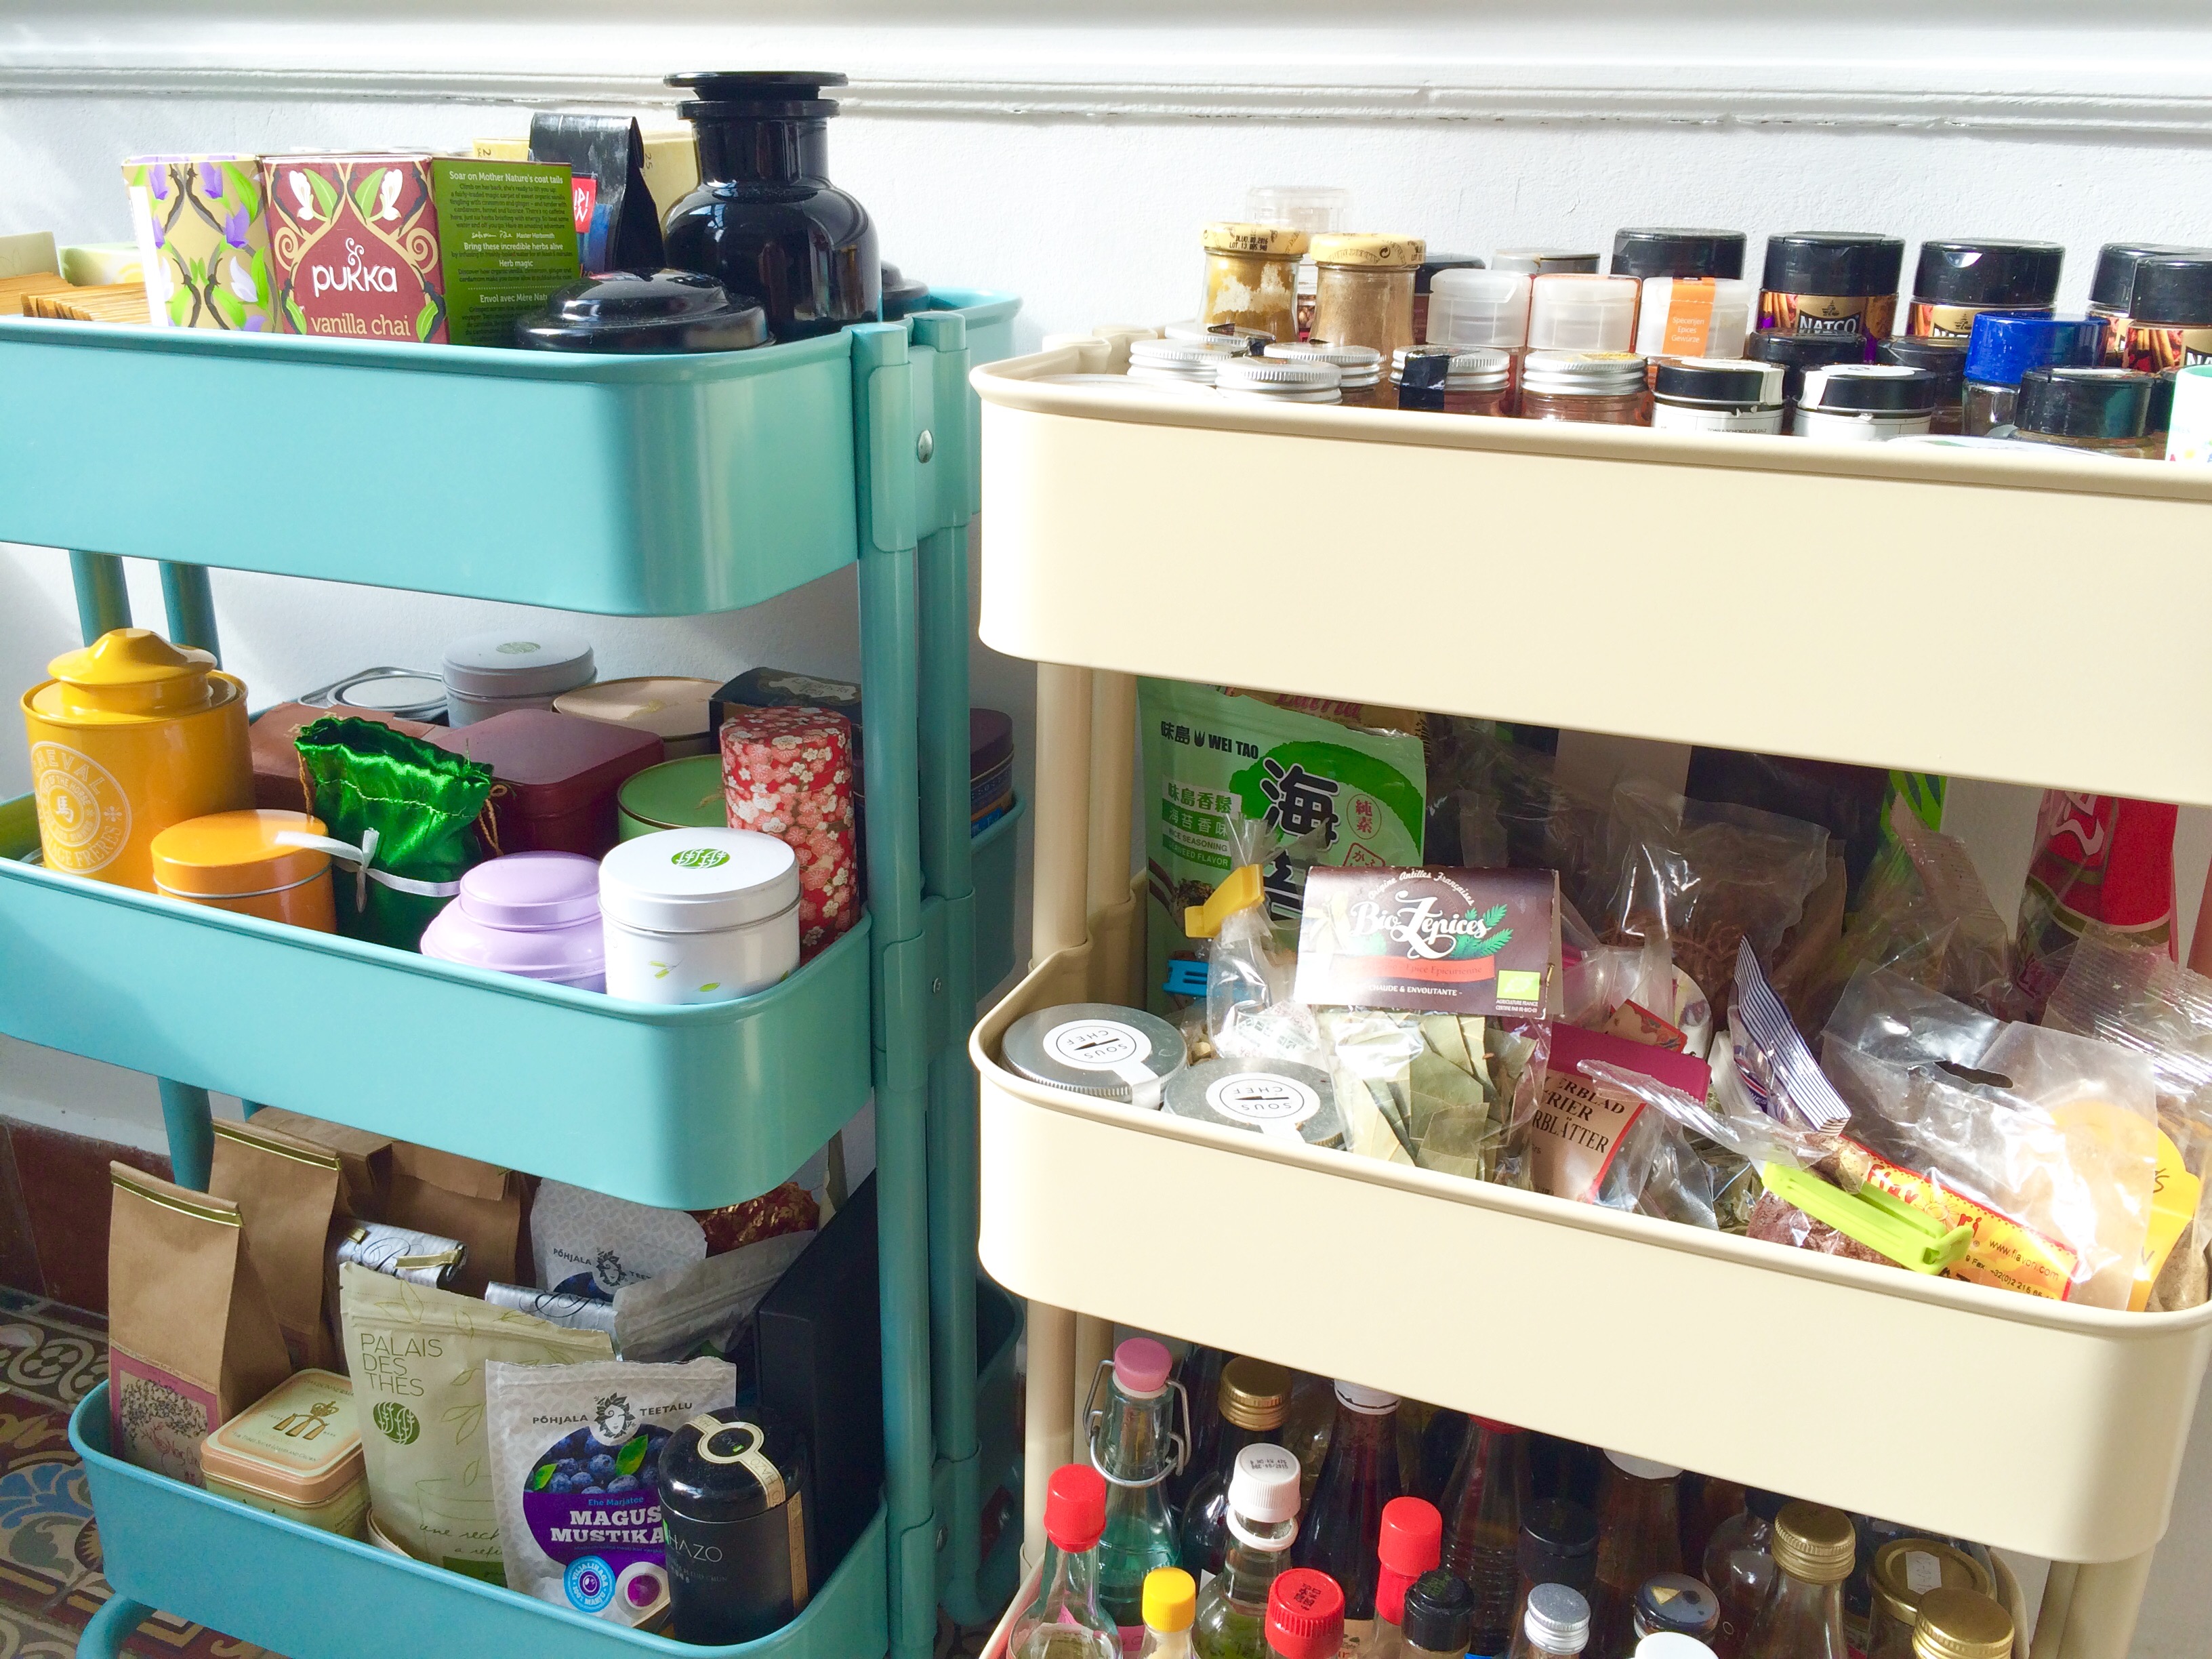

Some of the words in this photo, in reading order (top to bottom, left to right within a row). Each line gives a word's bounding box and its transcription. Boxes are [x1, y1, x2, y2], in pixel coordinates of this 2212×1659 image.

[449, 171, 466, 180] Soar
[468, 172, 478, 180] on
[478, 172, 504, 182] Mother
[505, 173, 533, 182] Nature's
[534, 174, 549, 183] coat
[550, 176, 563, 184] tails
[464, 242, 482, 252] Bring
[312, 238, 398, 298] pukka
[515, 260, 533, 268] magic
[480, 294, 499, 303] Envol
[516, 293, 533, 302] Mère
[310, 313, 367, 335] vanilla
[371, 314, 411, 336] chai
[1799, 314, 1857, 334] NATCO
[1671, 334, 1700, 344] Gewürze
[1161, 721, 1191, 745] 味島
[1208, 733, 1232, 754] WEI
[1235, 741, 1259, 760] TAO
[1183, 834, 1228, 852] SEASONING
[1197, 851, 1229, 867] FLAVOR
[1368, 877, 1398, 900] Origine
[1399, 868, 1432, 881] Antilles
[1433, 872, 1475, 907] Françaises
[1407, 986, 1457, 996] ENVOUTANTE
[1067, 1030, 1109, 1045] CHEF
[1084, 1043, 1128, 1059] SOUS
[1242, 1103, 1292, 1111] SOUS
[1532, 1109, 1609, 1153] RBLÄTTER
[1989, 1239, 2060, 1280] www.flavori.com
[361, 1333, 443, 1357] PALAIS
[363, 1353, 407, 1376] DES
[640, 1402, 693, 1416] TEETALU
[606, 1496, 644, 1507] Marjatee
[569, 1505, 662, 1526] MAGUS
[550, 1526, 665, 1544] MUSTIKA
